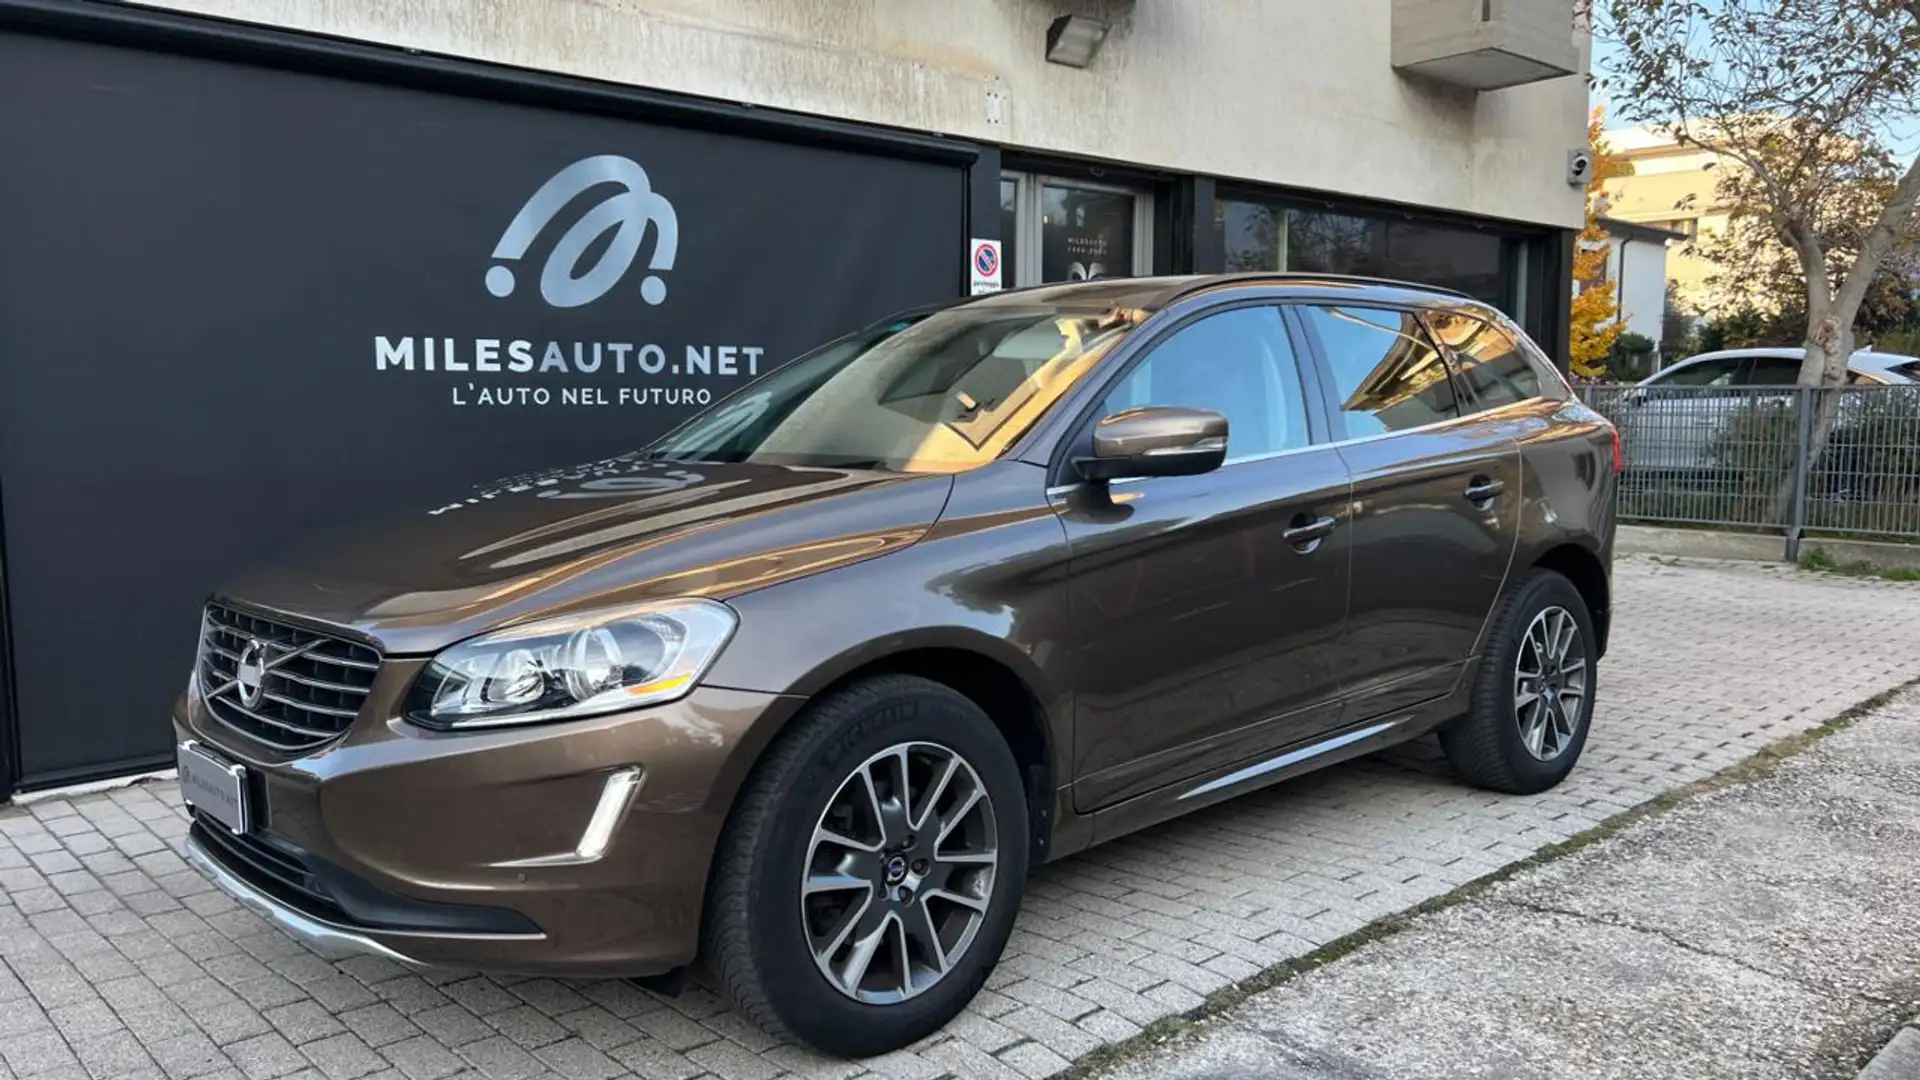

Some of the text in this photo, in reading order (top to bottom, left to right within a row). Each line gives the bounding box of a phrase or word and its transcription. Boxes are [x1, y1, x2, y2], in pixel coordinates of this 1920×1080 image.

[374, 336, 764, 375] MILESAUTO.NET
[452, 383, 711, 406] L'AUTO NEL FUTURO
